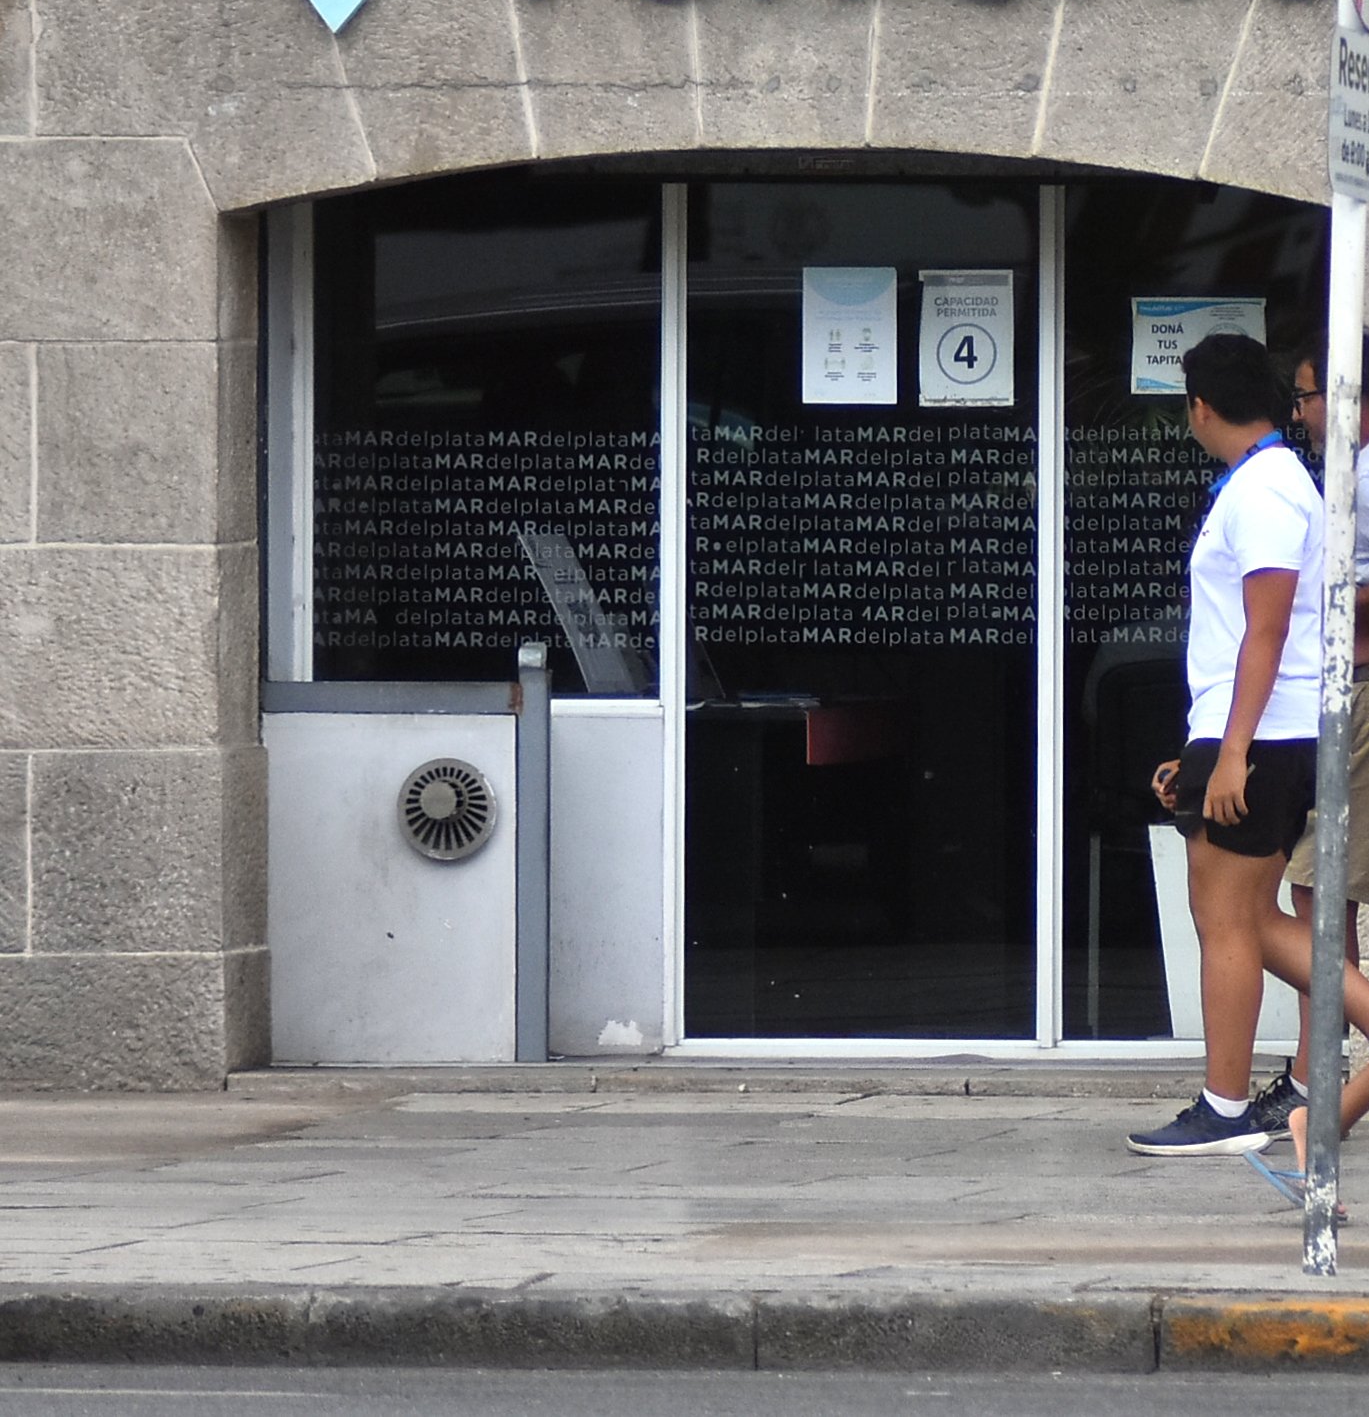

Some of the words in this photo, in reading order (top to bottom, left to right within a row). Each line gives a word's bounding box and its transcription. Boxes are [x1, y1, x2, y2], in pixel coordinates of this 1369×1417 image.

[934, 296, 999, 307] CAPACIDAD
[936, 307, 997, 318] PERMITIDA
[1151, 322, 1184, 334] DONÁ
[1157, 339, 1178, 350] TUS
[953, 334, 979, 370] 4
